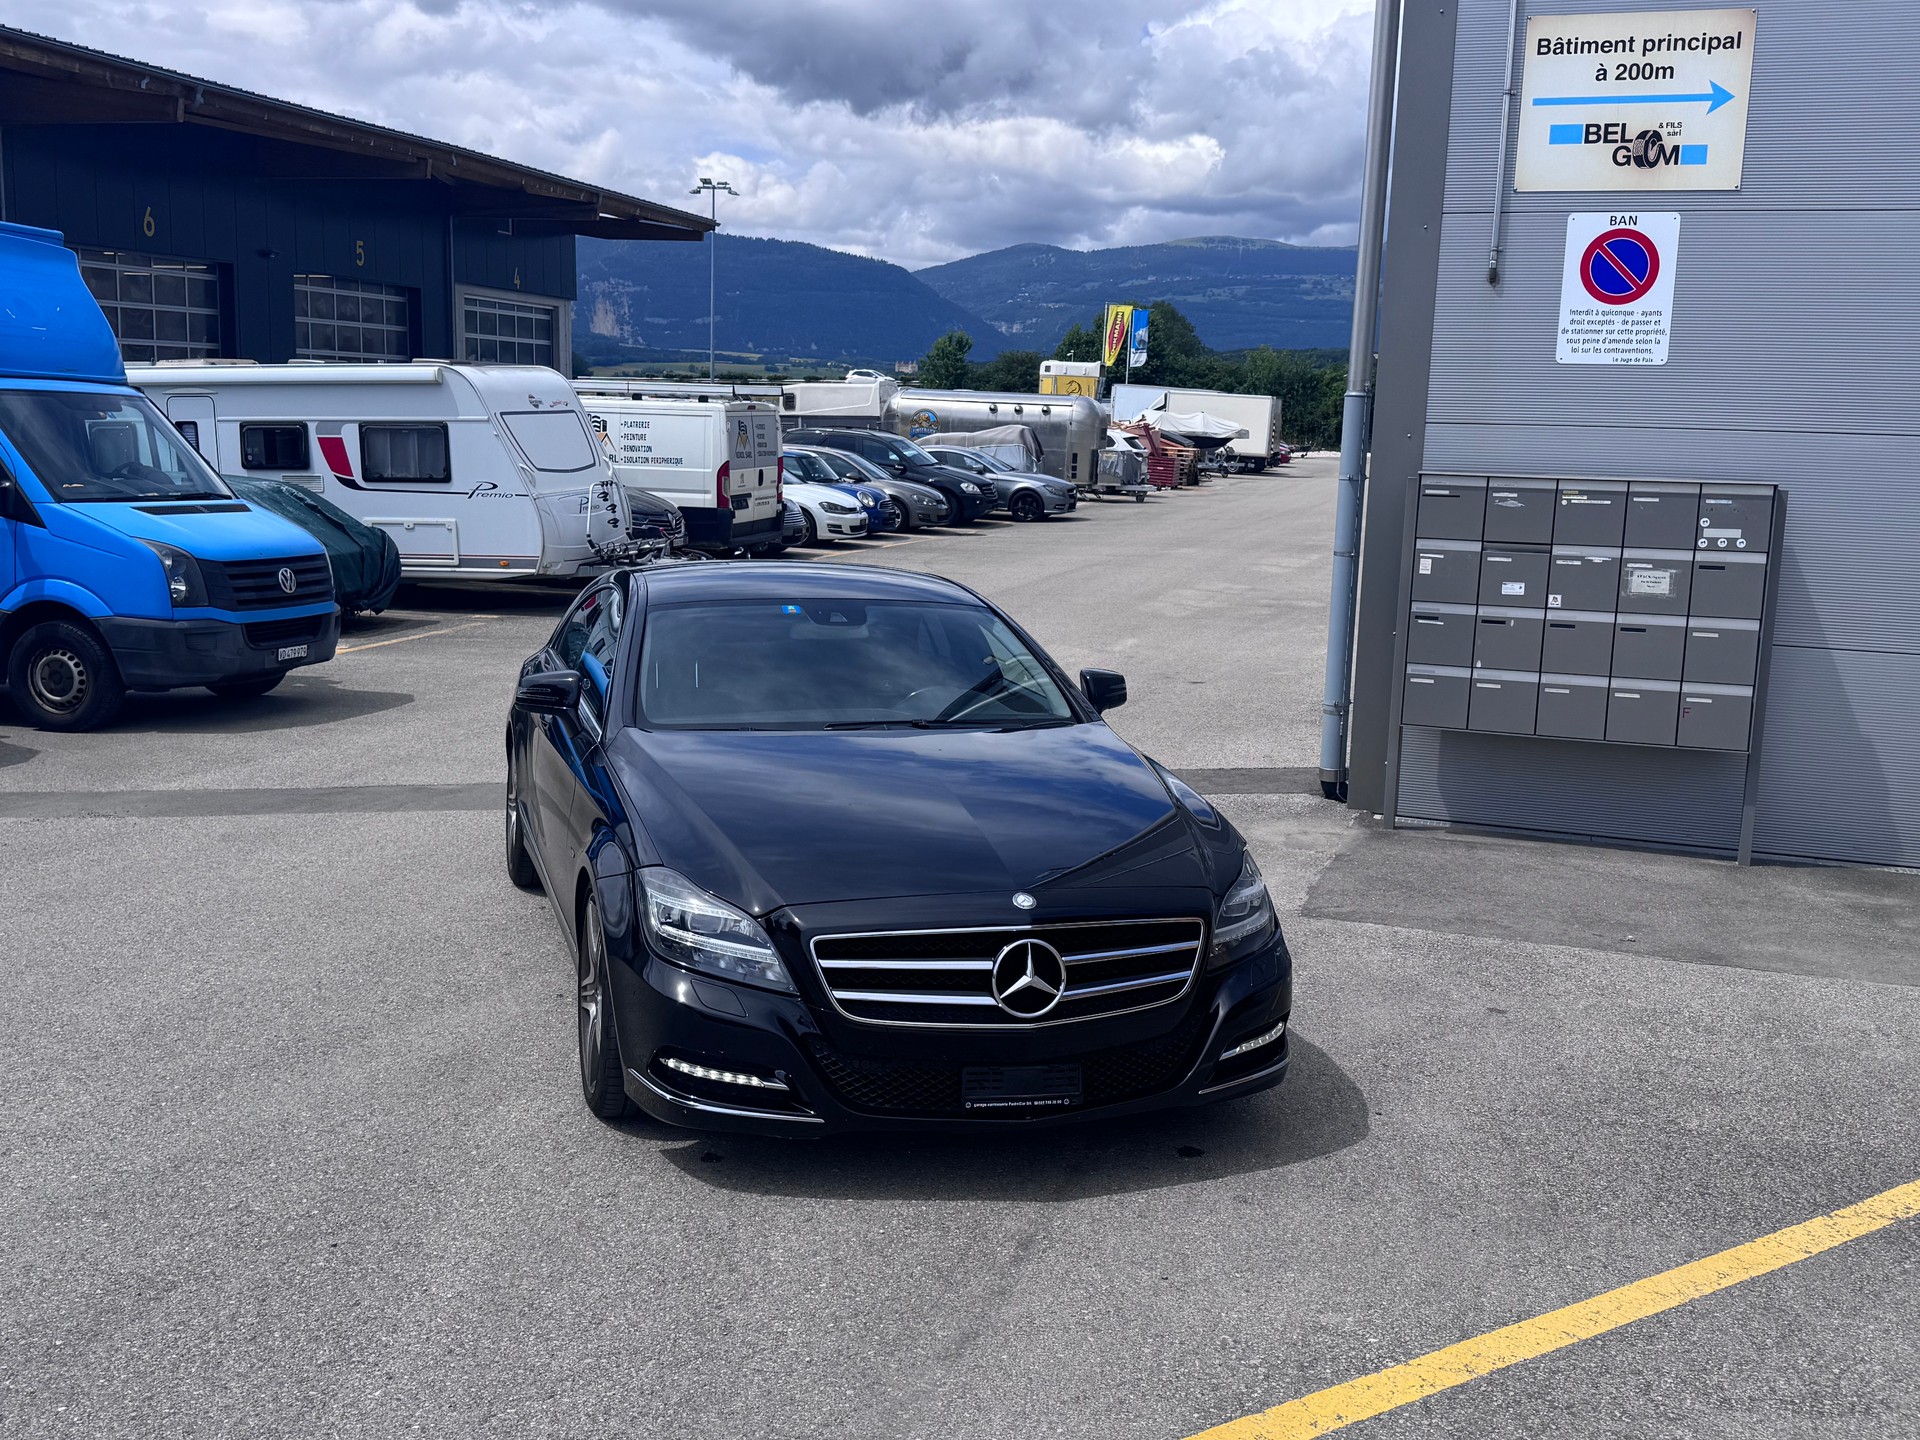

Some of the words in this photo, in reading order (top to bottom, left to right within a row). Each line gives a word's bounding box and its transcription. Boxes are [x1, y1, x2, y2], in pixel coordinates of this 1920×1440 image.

[1536, 36, 1636, 56] Bâtiment
[1642, 31, 1742, 57] principal
[1595, 63, 1608, 82] à
[1614, 62, 1674, 81] 200m
[1584, 122, 1634, 144] BEL
[143, 206, 156, 236] 6
[1609, 215, 1638, 226] BAN
[356, 240, 364, 266] 5
[514, 267, 520, 290] 4
[1635, 328, 1668, 336] propriété,
[650, 458, 683, 466] PERIPHERIQUE
[468, 480, 514, 499] Premio
[1683, 708, 1691, 718] F
